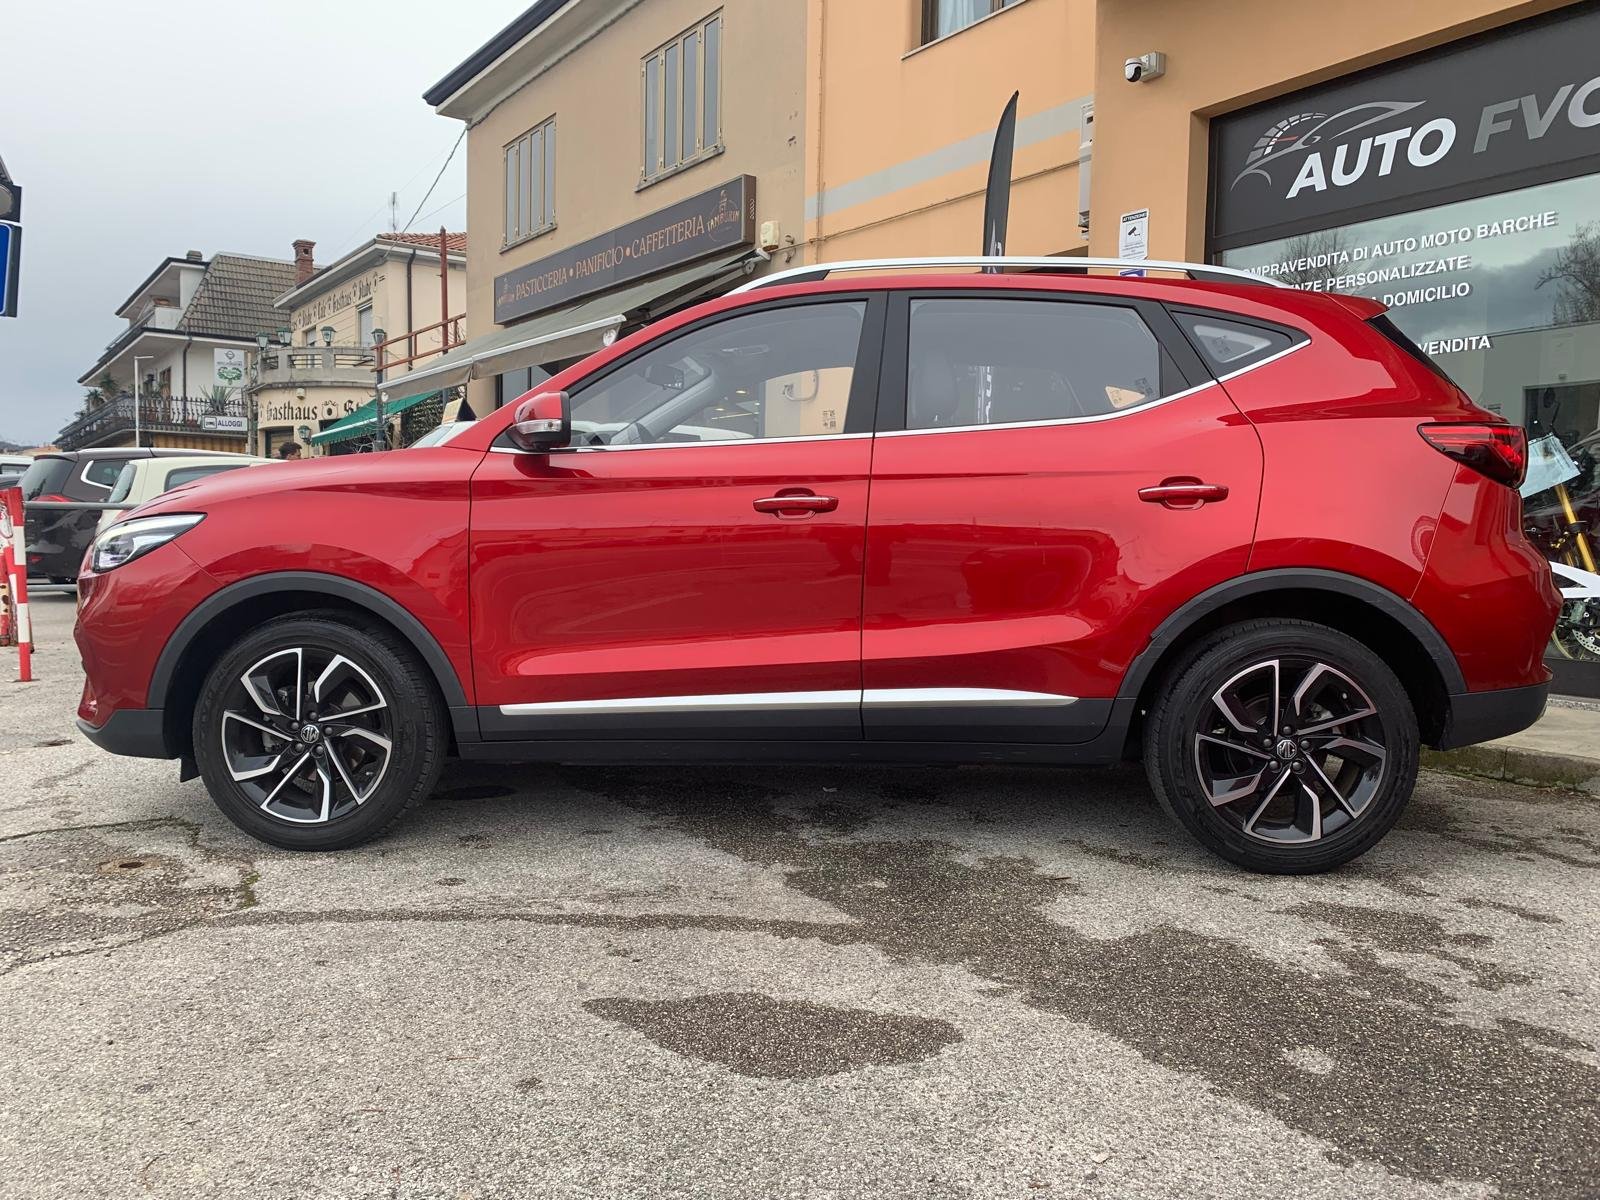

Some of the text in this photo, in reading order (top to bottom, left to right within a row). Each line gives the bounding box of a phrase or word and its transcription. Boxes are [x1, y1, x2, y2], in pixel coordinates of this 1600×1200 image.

[1286, 117, 1456, 199] AUTO
[1353, 246, 1368, 261] DI
[1372, 237, 1416, 258] AUTO
[1421, 227, 1471, 249] MOTO
[1476, 211, 1556, 239] BARCHE
[515, 214, 705, 300] PASTICCERIA PANIFICIO CAFFETTERIA
[1326, 255, 1470, 291] PERSONALIZZATE
[1383, 282, 1470, 308] DOMICILIO
[217, 420, 243, 428] ALLOGGI
[266, 400, 318, 421] Gasthaus
